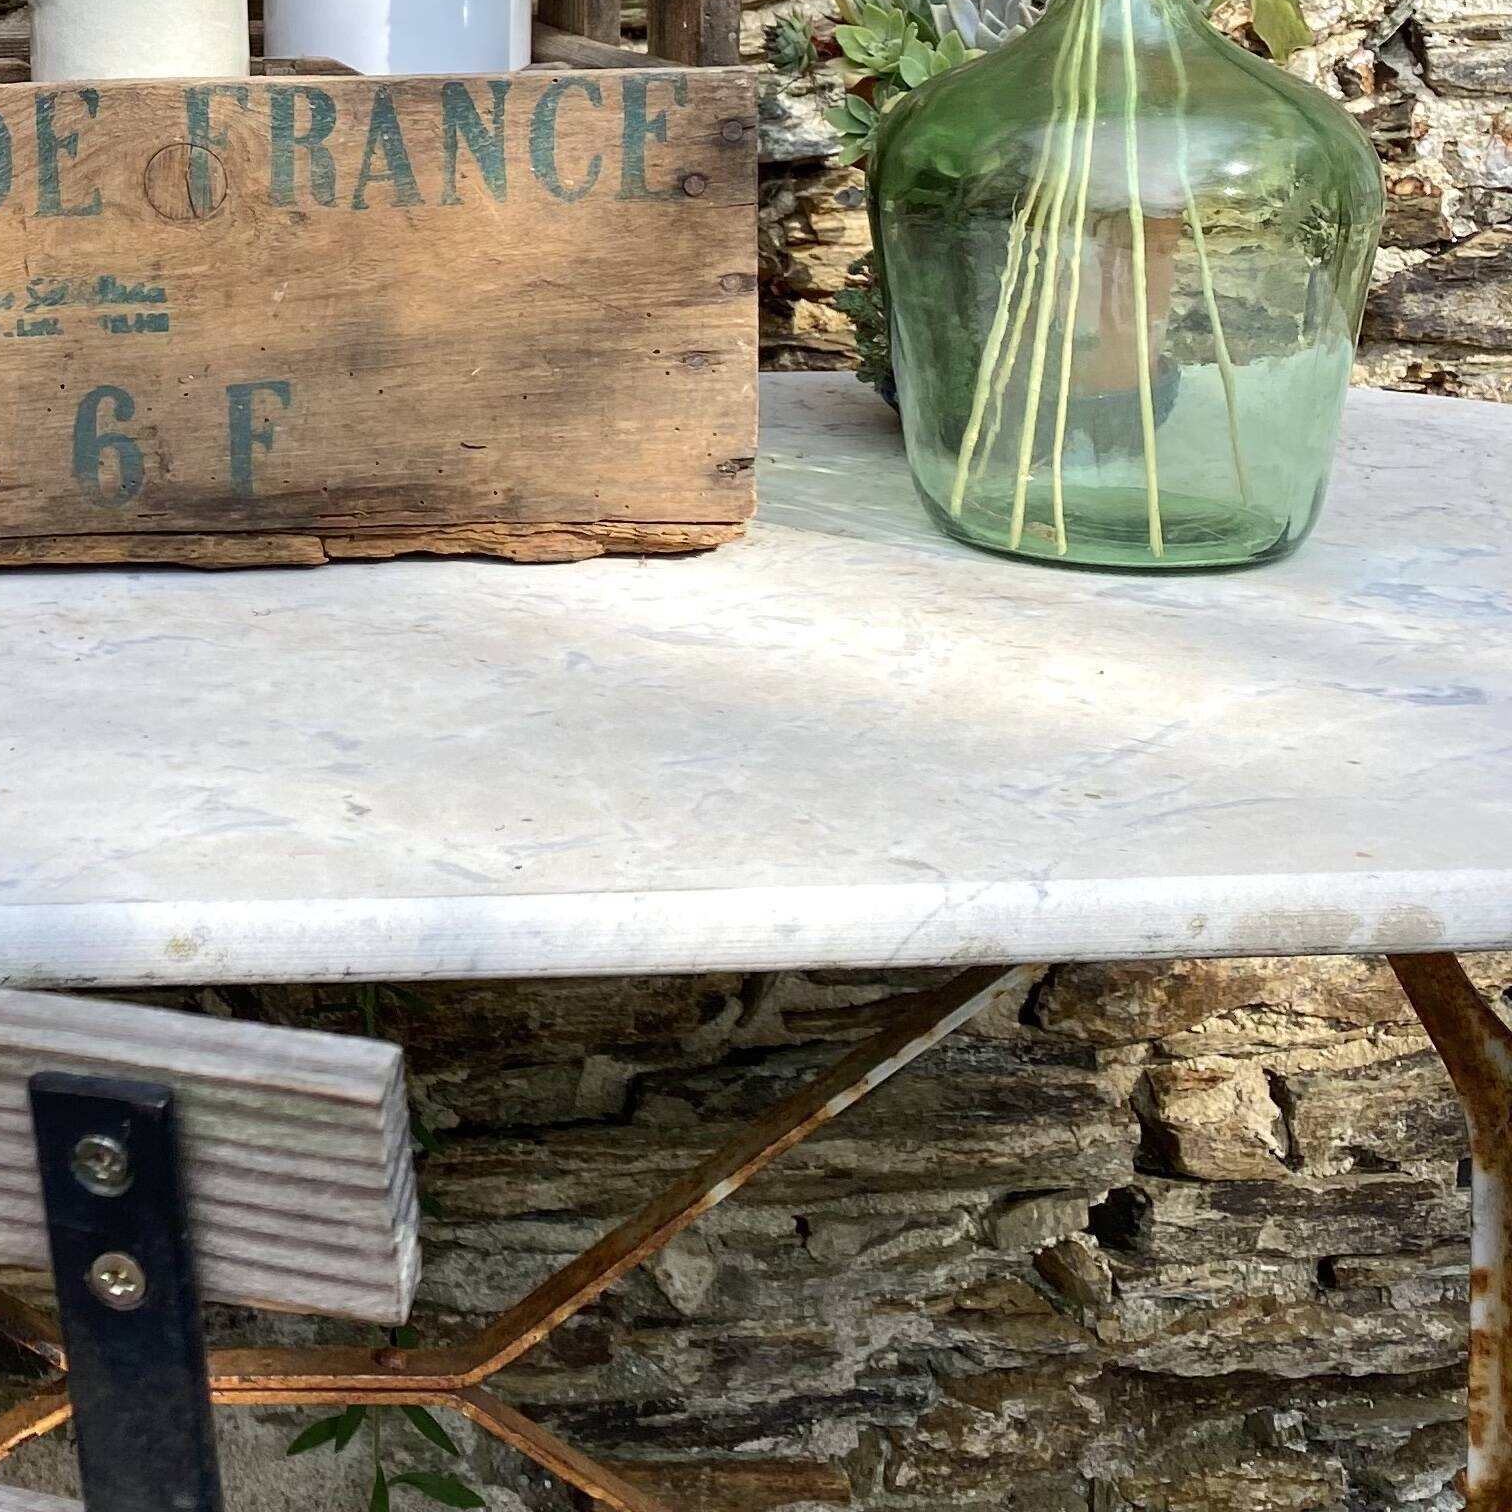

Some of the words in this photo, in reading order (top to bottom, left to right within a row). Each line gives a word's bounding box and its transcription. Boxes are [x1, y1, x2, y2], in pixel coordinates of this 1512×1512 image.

[184, 72, 690, 211] FRANCE
[72, 384, 145, 509] 6
[226, 380, 292, 502] F
